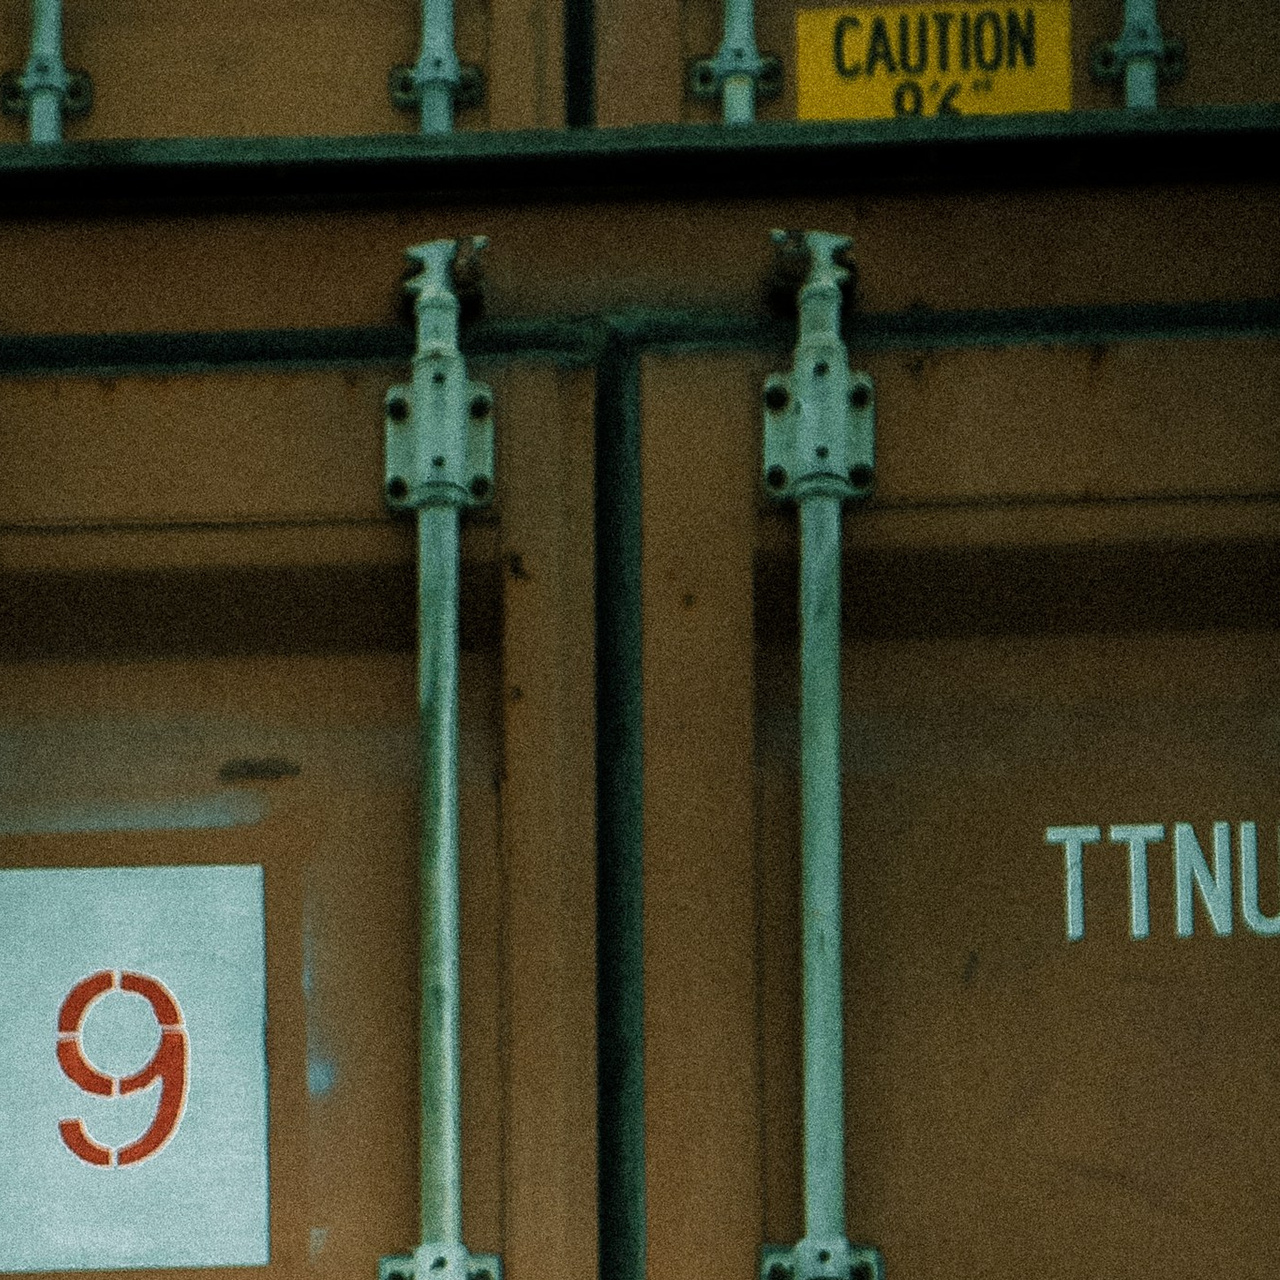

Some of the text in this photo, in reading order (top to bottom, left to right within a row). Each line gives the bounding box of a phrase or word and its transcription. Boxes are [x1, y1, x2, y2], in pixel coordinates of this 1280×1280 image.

[832, 9, 1036, 79] CAUTION
[1045, 820, 1280, 942] TTNU
[56, 969, 188, 1167] 9
